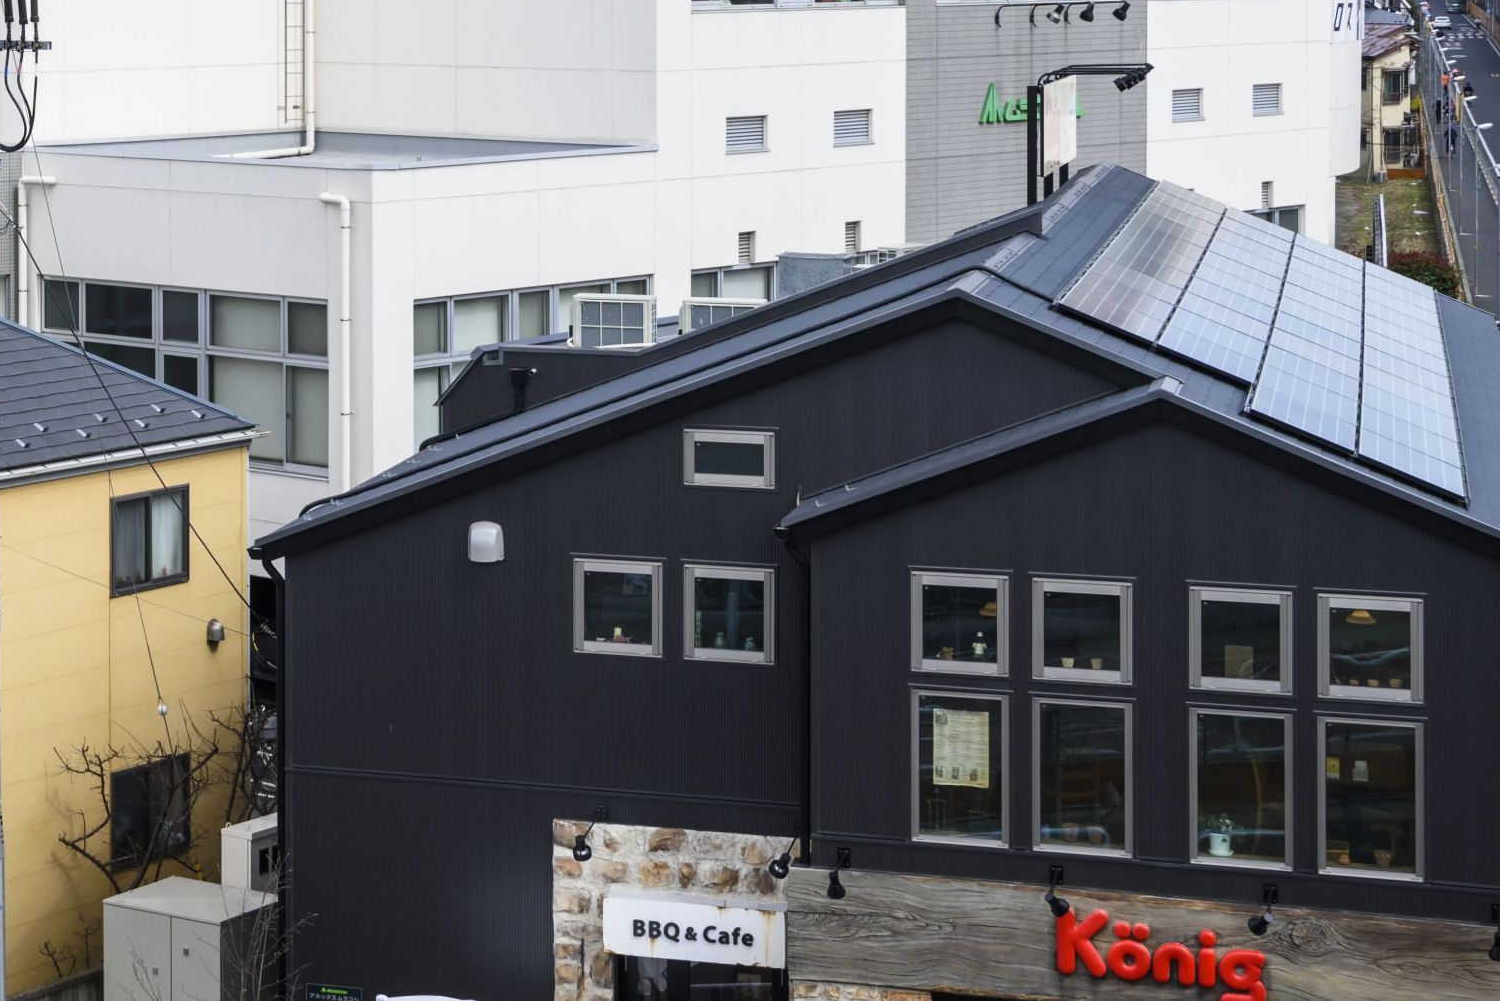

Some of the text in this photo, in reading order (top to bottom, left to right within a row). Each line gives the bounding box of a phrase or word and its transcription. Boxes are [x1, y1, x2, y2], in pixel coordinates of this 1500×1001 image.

[632, 919, 754, 947] BBQ & Cafe
[1056, 906, 1268, 1001] König
